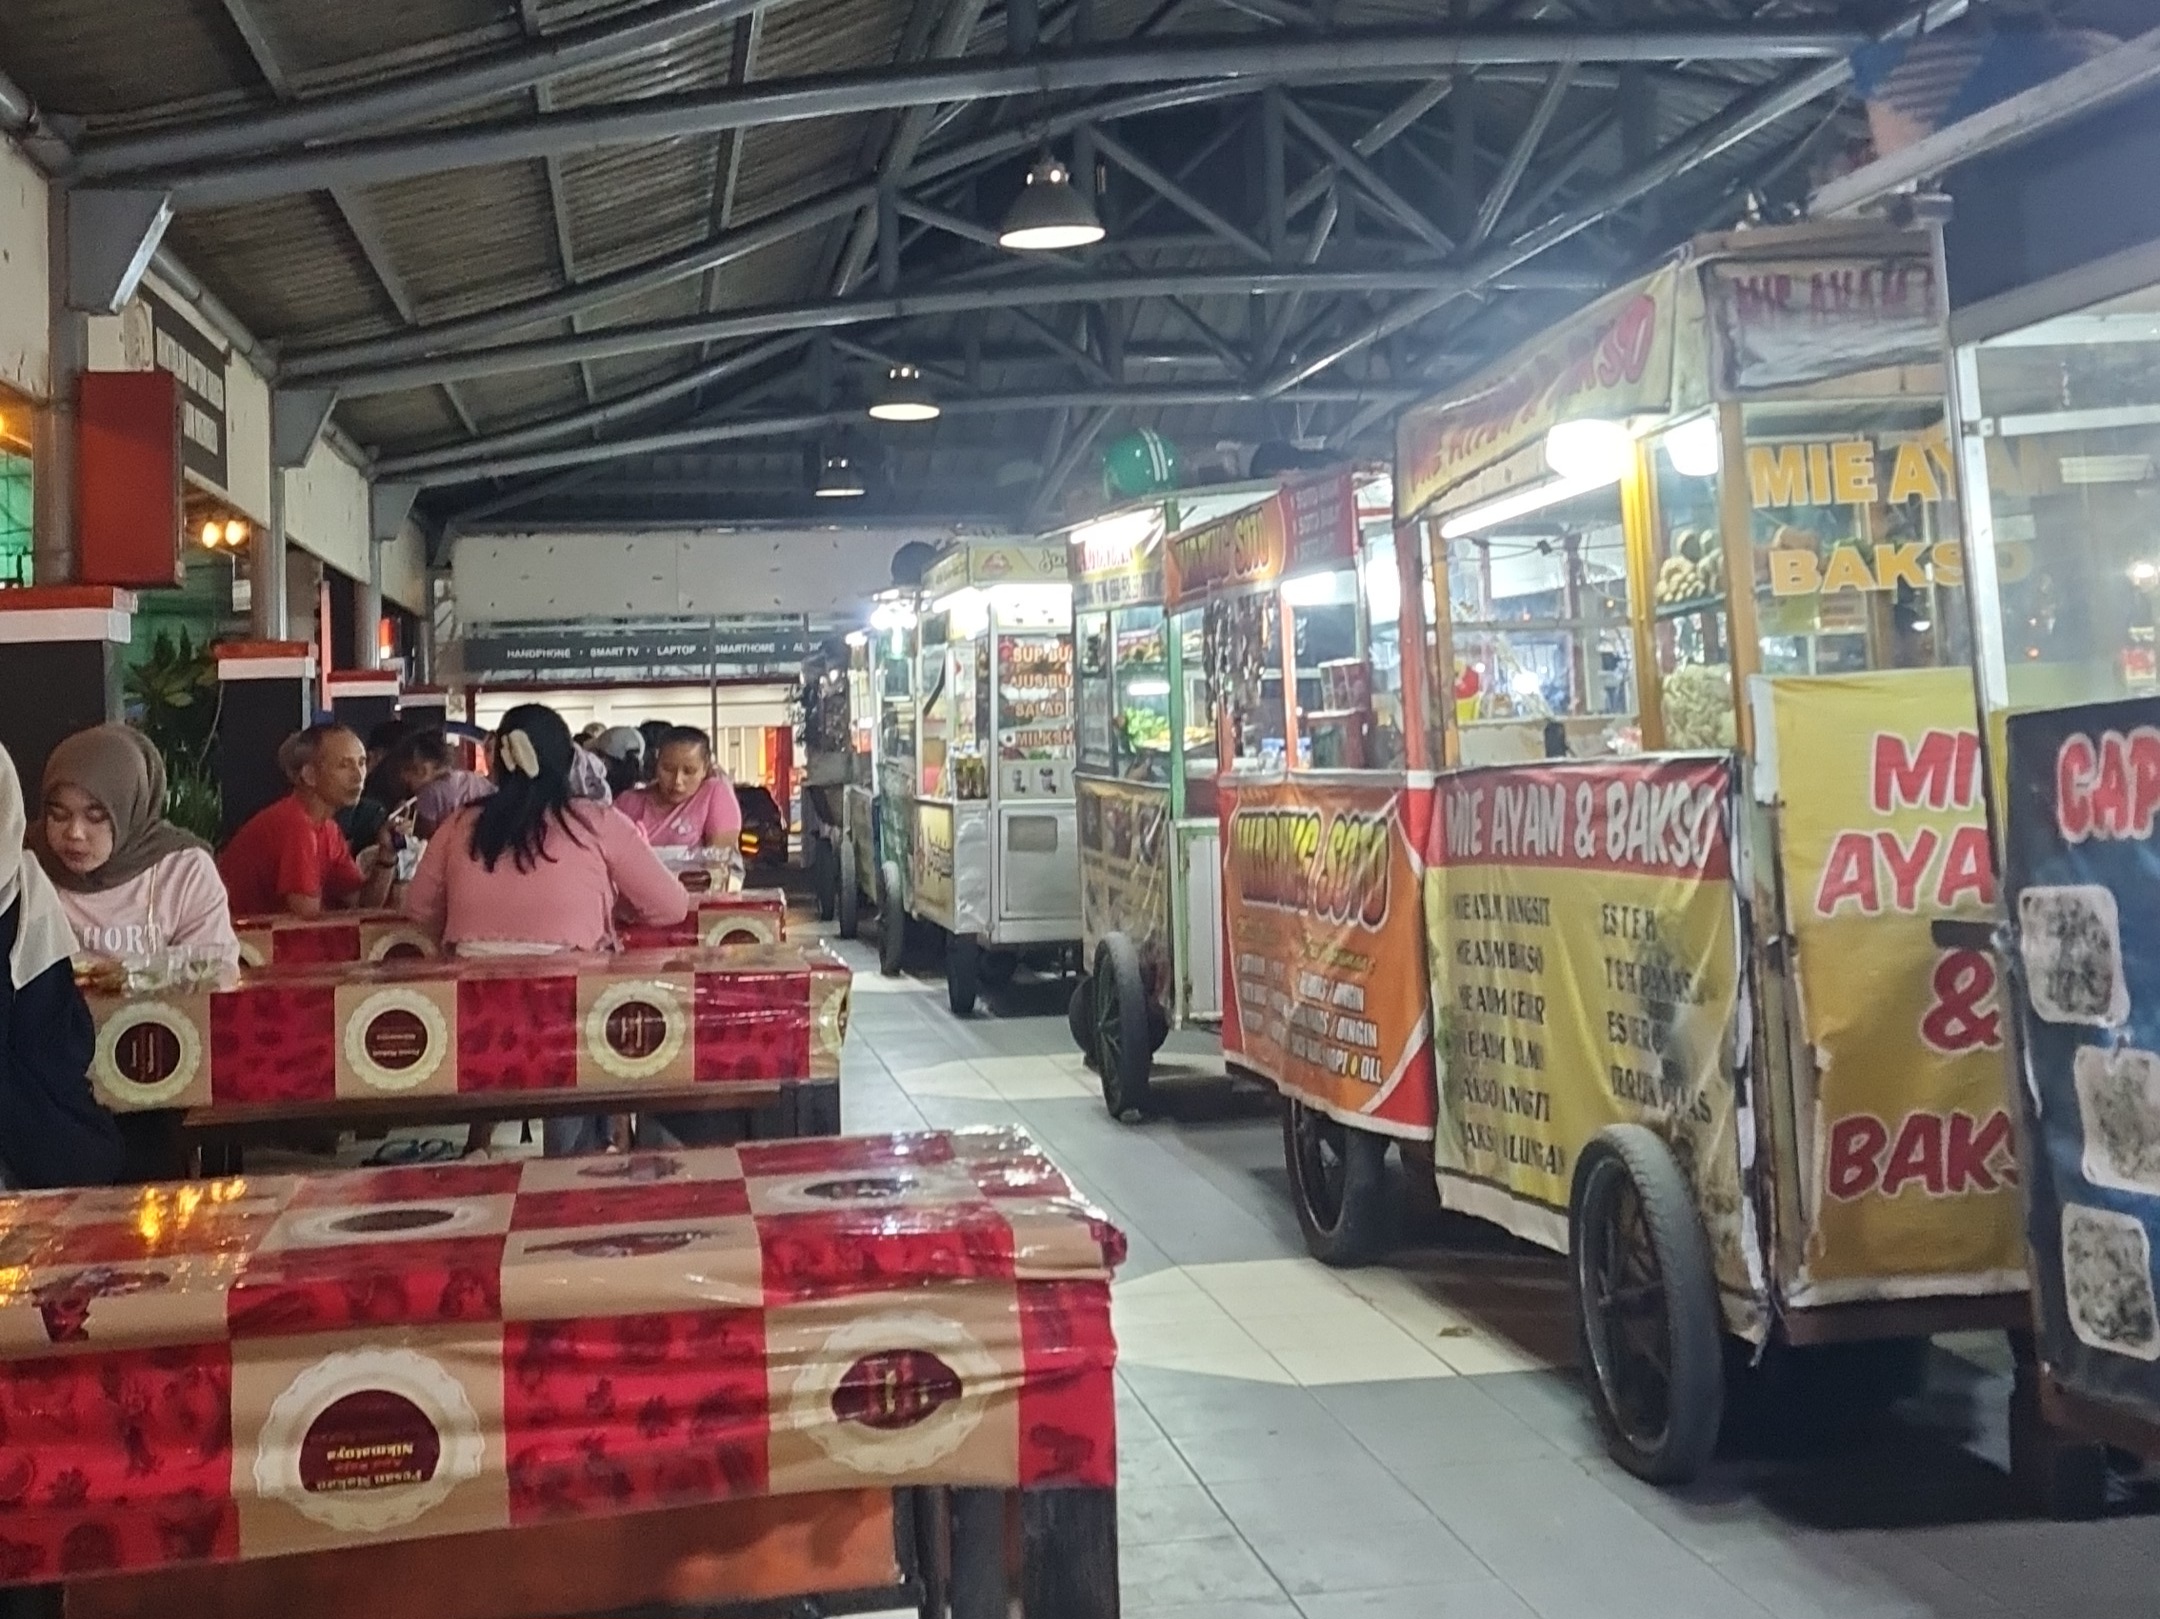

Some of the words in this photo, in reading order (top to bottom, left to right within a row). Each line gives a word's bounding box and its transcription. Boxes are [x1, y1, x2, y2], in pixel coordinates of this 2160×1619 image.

[1746, 440, 1878, 508] MIE
[507, 648, 571, 659] HANDPHONE
[590, 646, 625, 658] SMART
[627, 646, 640, 657] TV
[657, 645, 697, 657] LAPTOP
[715, 643, 775, 655] SMARTHOME
[1873, 730, 1983, 814] MI
[1446, 787, 1484, 857] MIE
[1491, 783, 1567, 857] AYAM
[1574, 780, 1596, 859] &
[1606, 780, 1719, 869] BAKSO
[1920, 946, 2002, 1054] &
